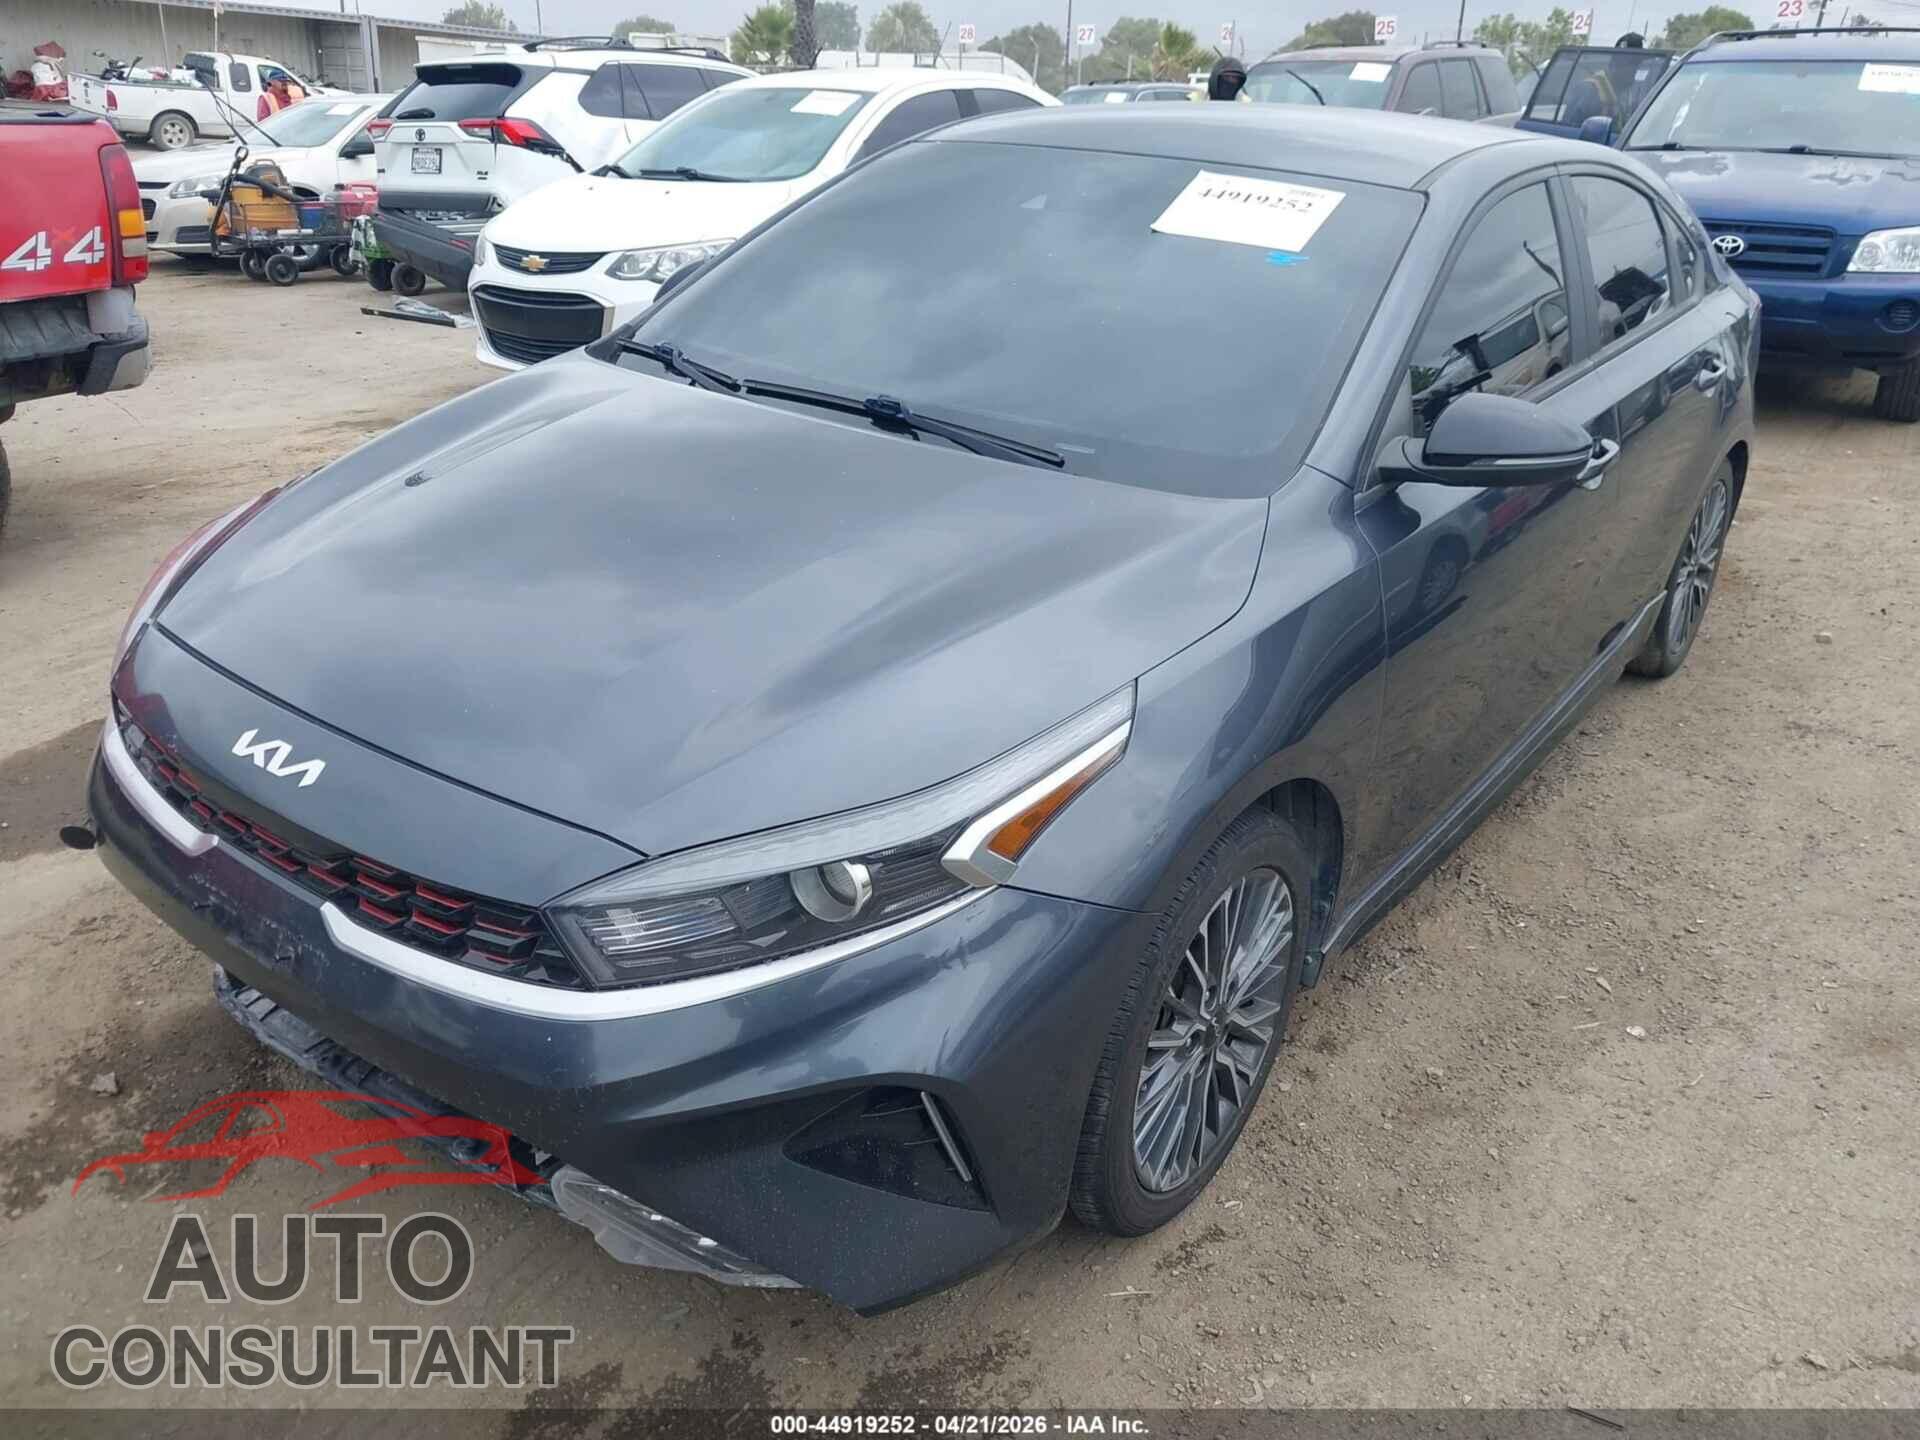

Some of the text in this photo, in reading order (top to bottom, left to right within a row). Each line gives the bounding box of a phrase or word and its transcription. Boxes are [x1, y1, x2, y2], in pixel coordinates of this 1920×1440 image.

[1777, 0, 1803, 17] 23
[960, 28, 974, 40] 28
[1079, 28, 1094, 41] 27
[1376, 20, 1395, 35] 25
